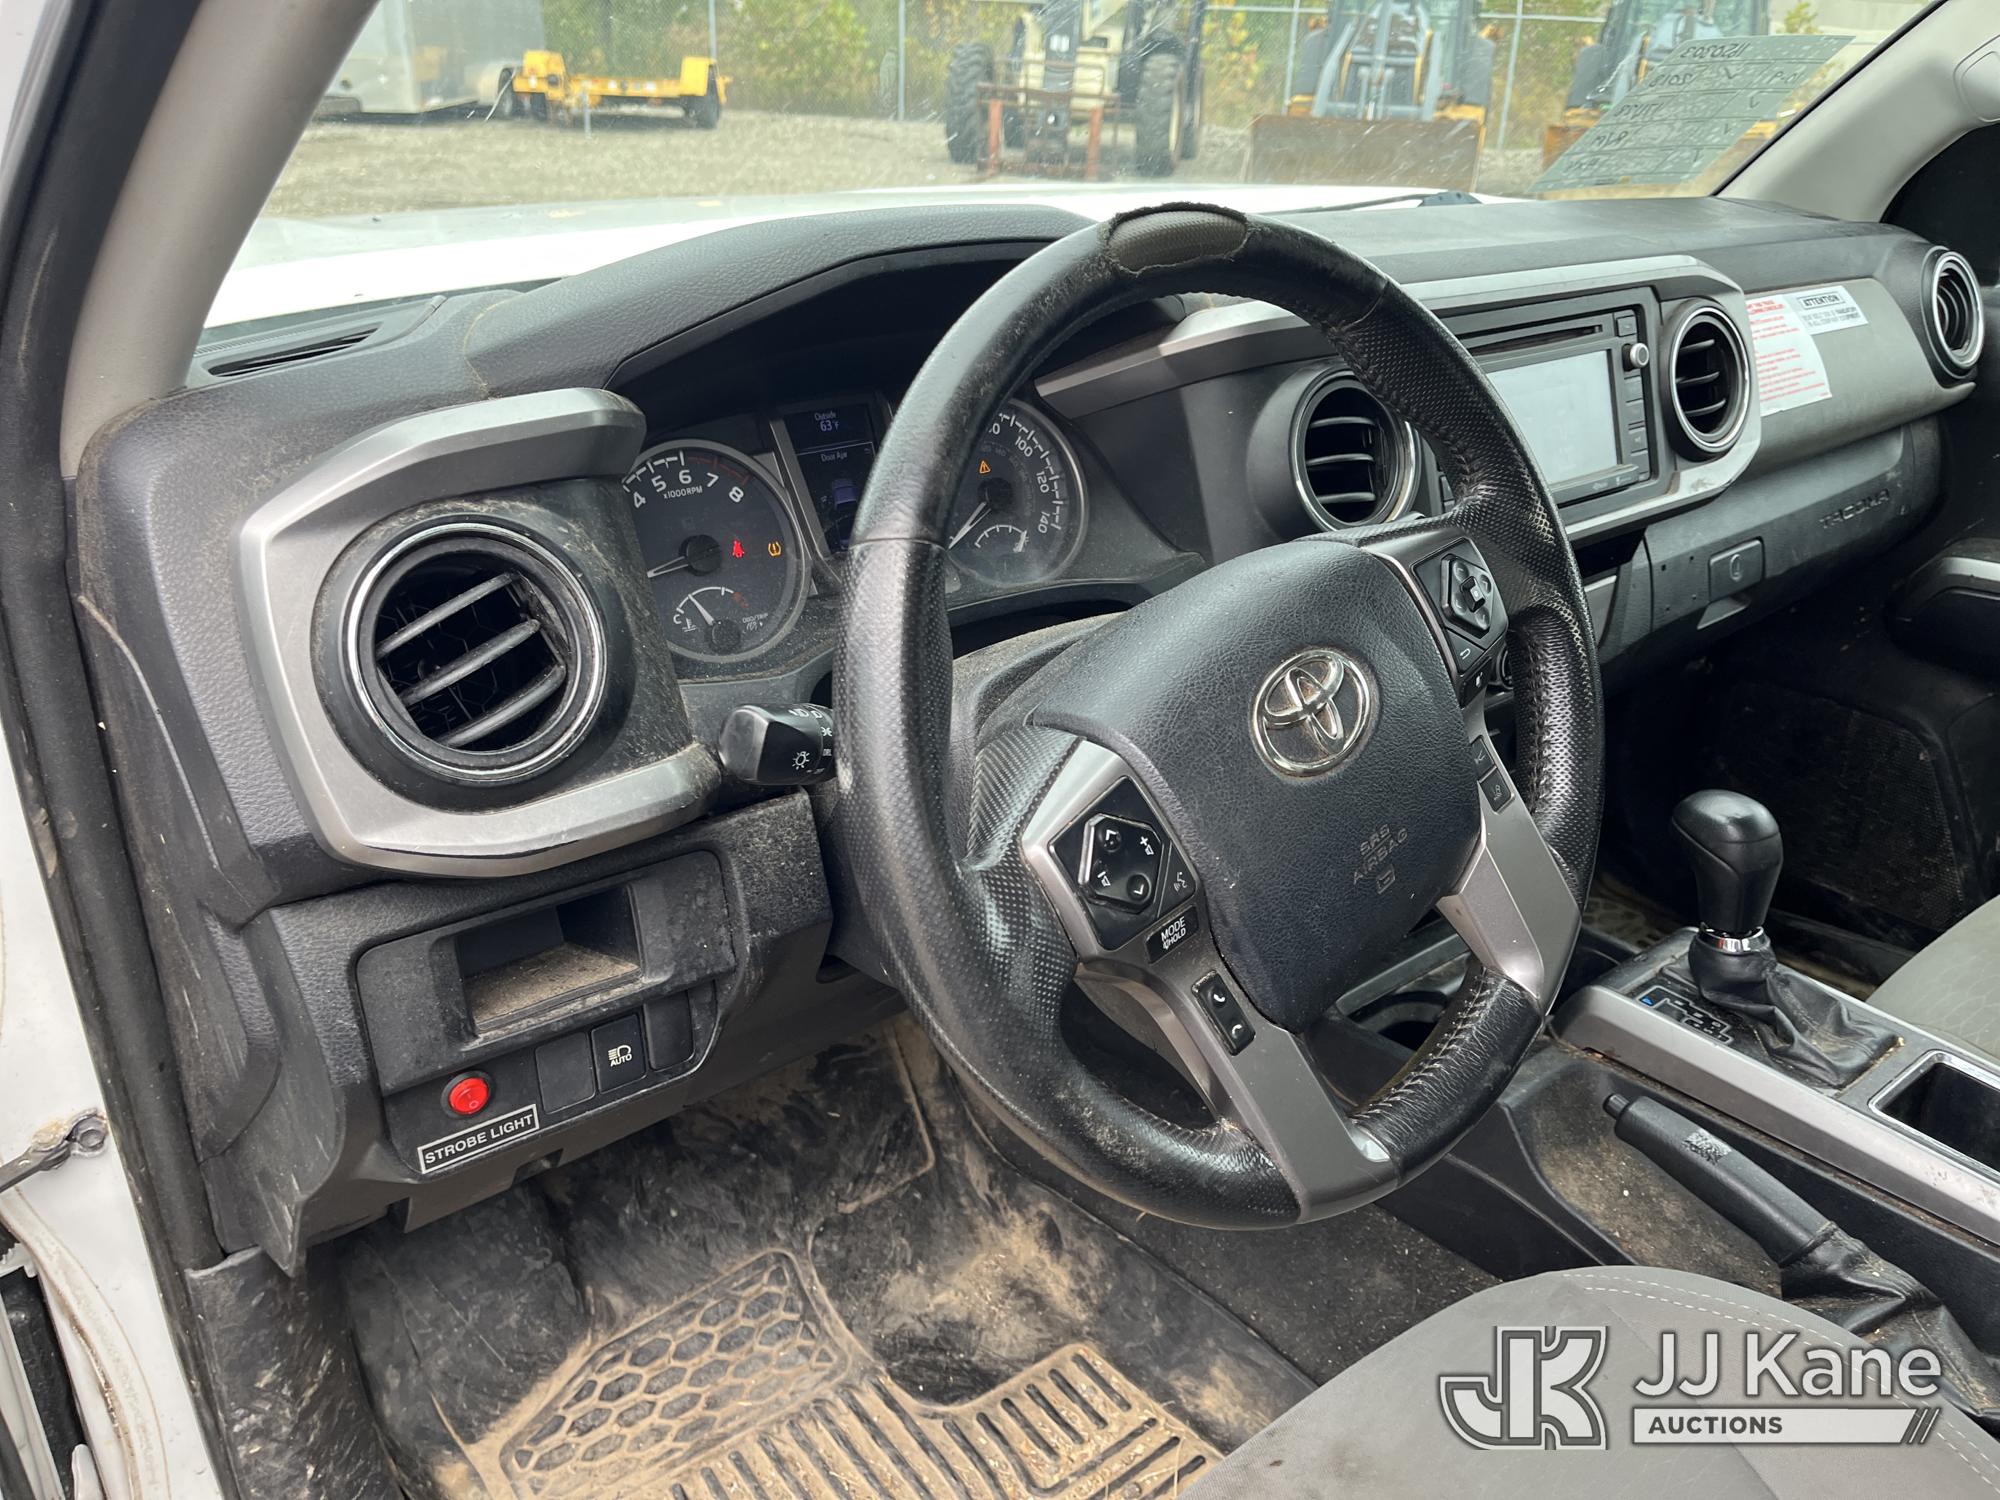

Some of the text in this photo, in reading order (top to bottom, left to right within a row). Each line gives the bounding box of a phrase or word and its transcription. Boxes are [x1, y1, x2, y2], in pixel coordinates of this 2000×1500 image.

[1015, 436, 1033, 457] 100
[651, 475, 667, 492] 5
[679, 469, 692, 484] 6
[707, 472, 719, 487] 7
[1036, 471, 1050, 493] 120
[633, 492, 646, 508] 4
[729, 486, 744, 502] 8
[1038, 511, 1050, 534] 140
[1161, 916, 1186, 943] MODE
[610, 1053, 633, 1067] AUTO
[424, 1114, 533, 1164] STROBE LIGHT
